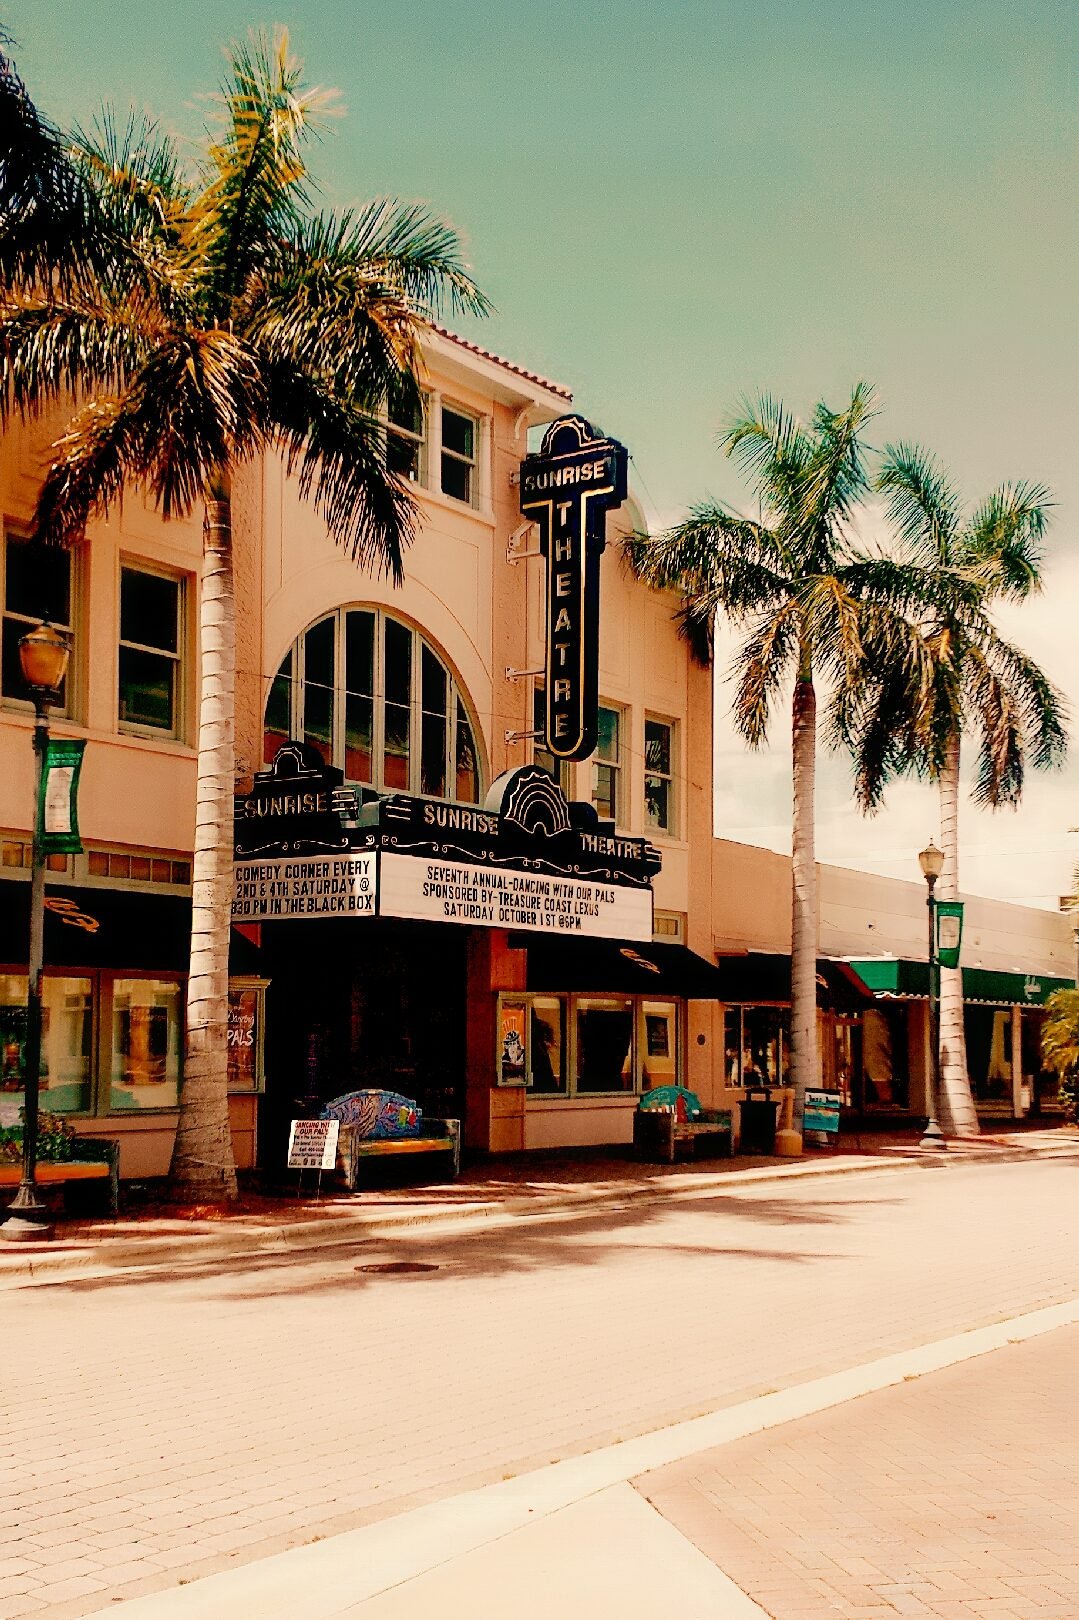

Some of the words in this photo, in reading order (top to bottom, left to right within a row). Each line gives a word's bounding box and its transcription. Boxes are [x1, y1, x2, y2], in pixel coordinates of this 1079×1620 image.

[525, 458, 607, 492] SUNRISE
[554, 501, 573, 737] THEATRE
[244, 792, 328, 818] SUNRISE
[424, 804, 499, 836] SUNRISE
[579, 832, 642, 860] THEATRE
[236, 865, 282, 882] COMEDY
[285, 862, 330, 879] CORNER
[333, 860, 371, 876] EVERY
[427, 865, 469, 885] SEVENTH
[553, 883, 574, 899] WITH
[576, 886, 592, 901] OUR
[595, 888, 615, 904] PALS
[236, 882, 257, 898] 2ND
[260, 882, 267, 897] &
[269, 881, 289, 897] 4TH
[293, 878, 356, 896] SATURDAY
[359, 877, 370, 892] @
[423, 881, 478, 902] SPONSORED
[544, 897, 572, 914] COAST
[574, 901, 599, 917] LEXUS
[253, 899, 268, 915] PM
[270, 899, 282, 915] IN
[286, 898, 305, 913] THE
[306, 896, 346, 913] BLACK
[350, 894, 373, 910] BOX
[444, 901, 494, 920] SATURDAY
[498, 907, 537, 926] OCTOBER
[227, 1029, 254, 1047] PALS
